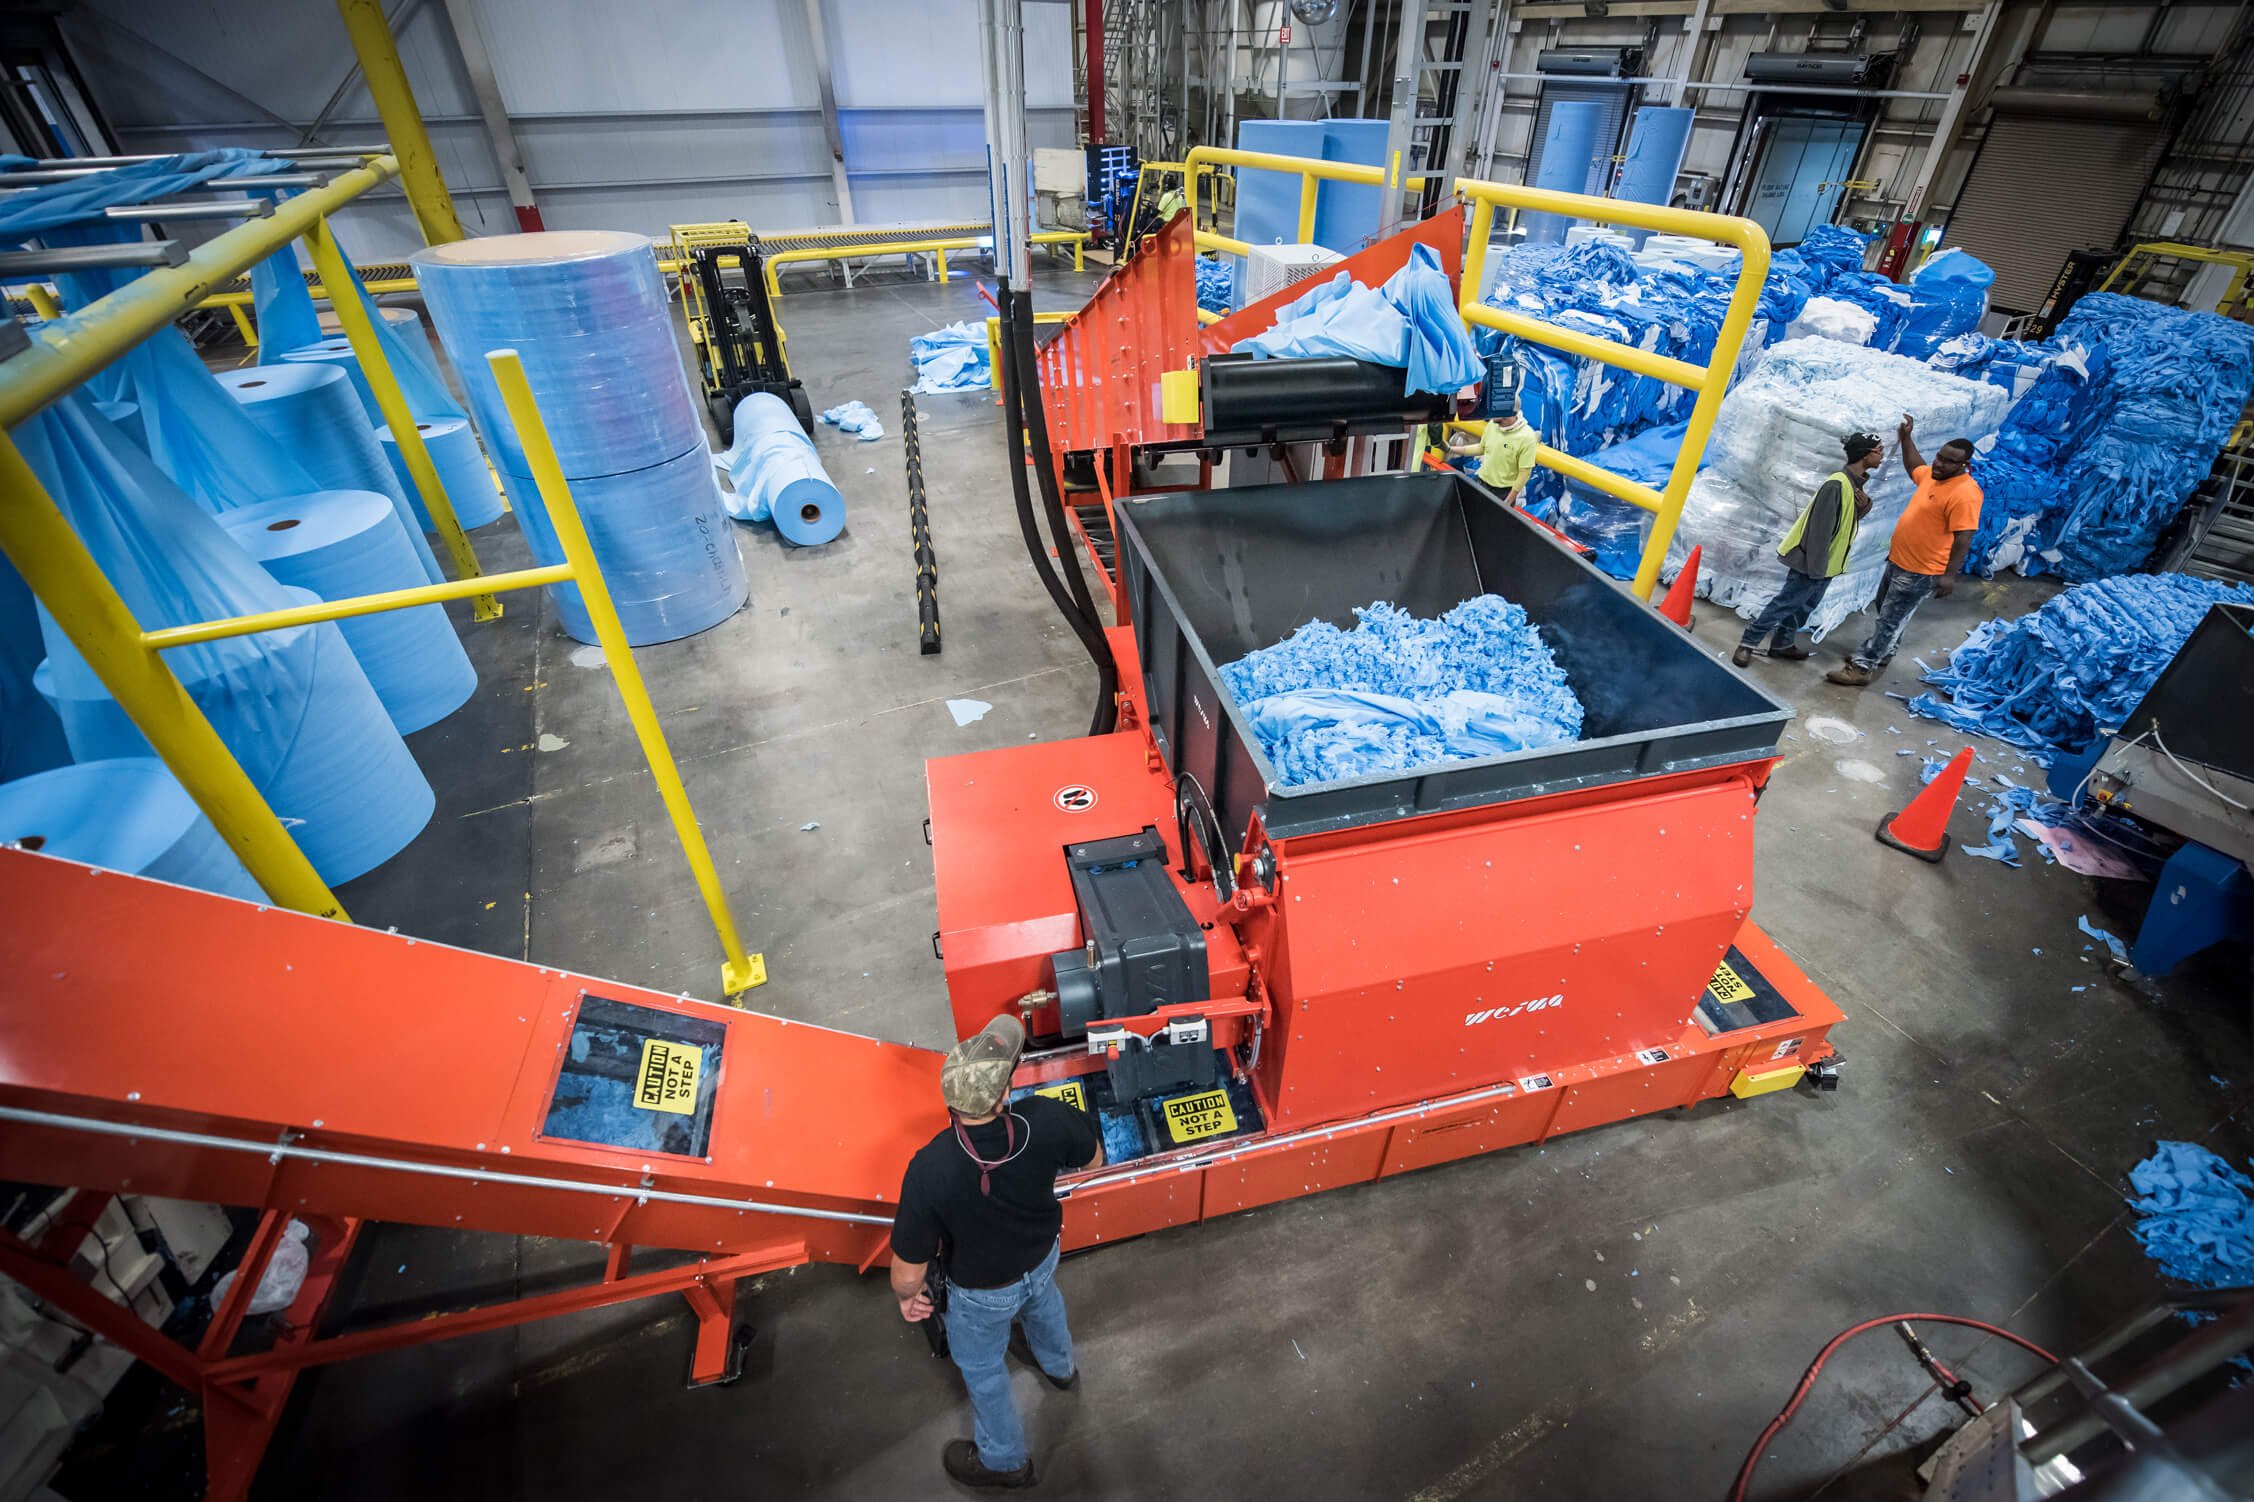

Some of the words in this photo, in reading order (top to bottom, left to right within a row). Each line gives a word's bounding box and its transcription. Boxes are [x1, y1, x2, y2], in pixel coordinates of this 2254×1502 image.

[2051, 261, 2076, 299] HYSTER
[1464, 993, 1564, 1026] weima
[643, 1045, 668, 1104] CAUTION
[671, 1055, 683, 1065] A
[665, 1068, 680, 1100] NOT
[680, 1060, 695, 1098] STEP
[1170, 1095, 1225, 1117] CAUTION
[1179, 1112, 1209, 1126] NOT
[1213, 1110, 1224, 1119] A
[1186, 1121, 1222, 1135] STEP
